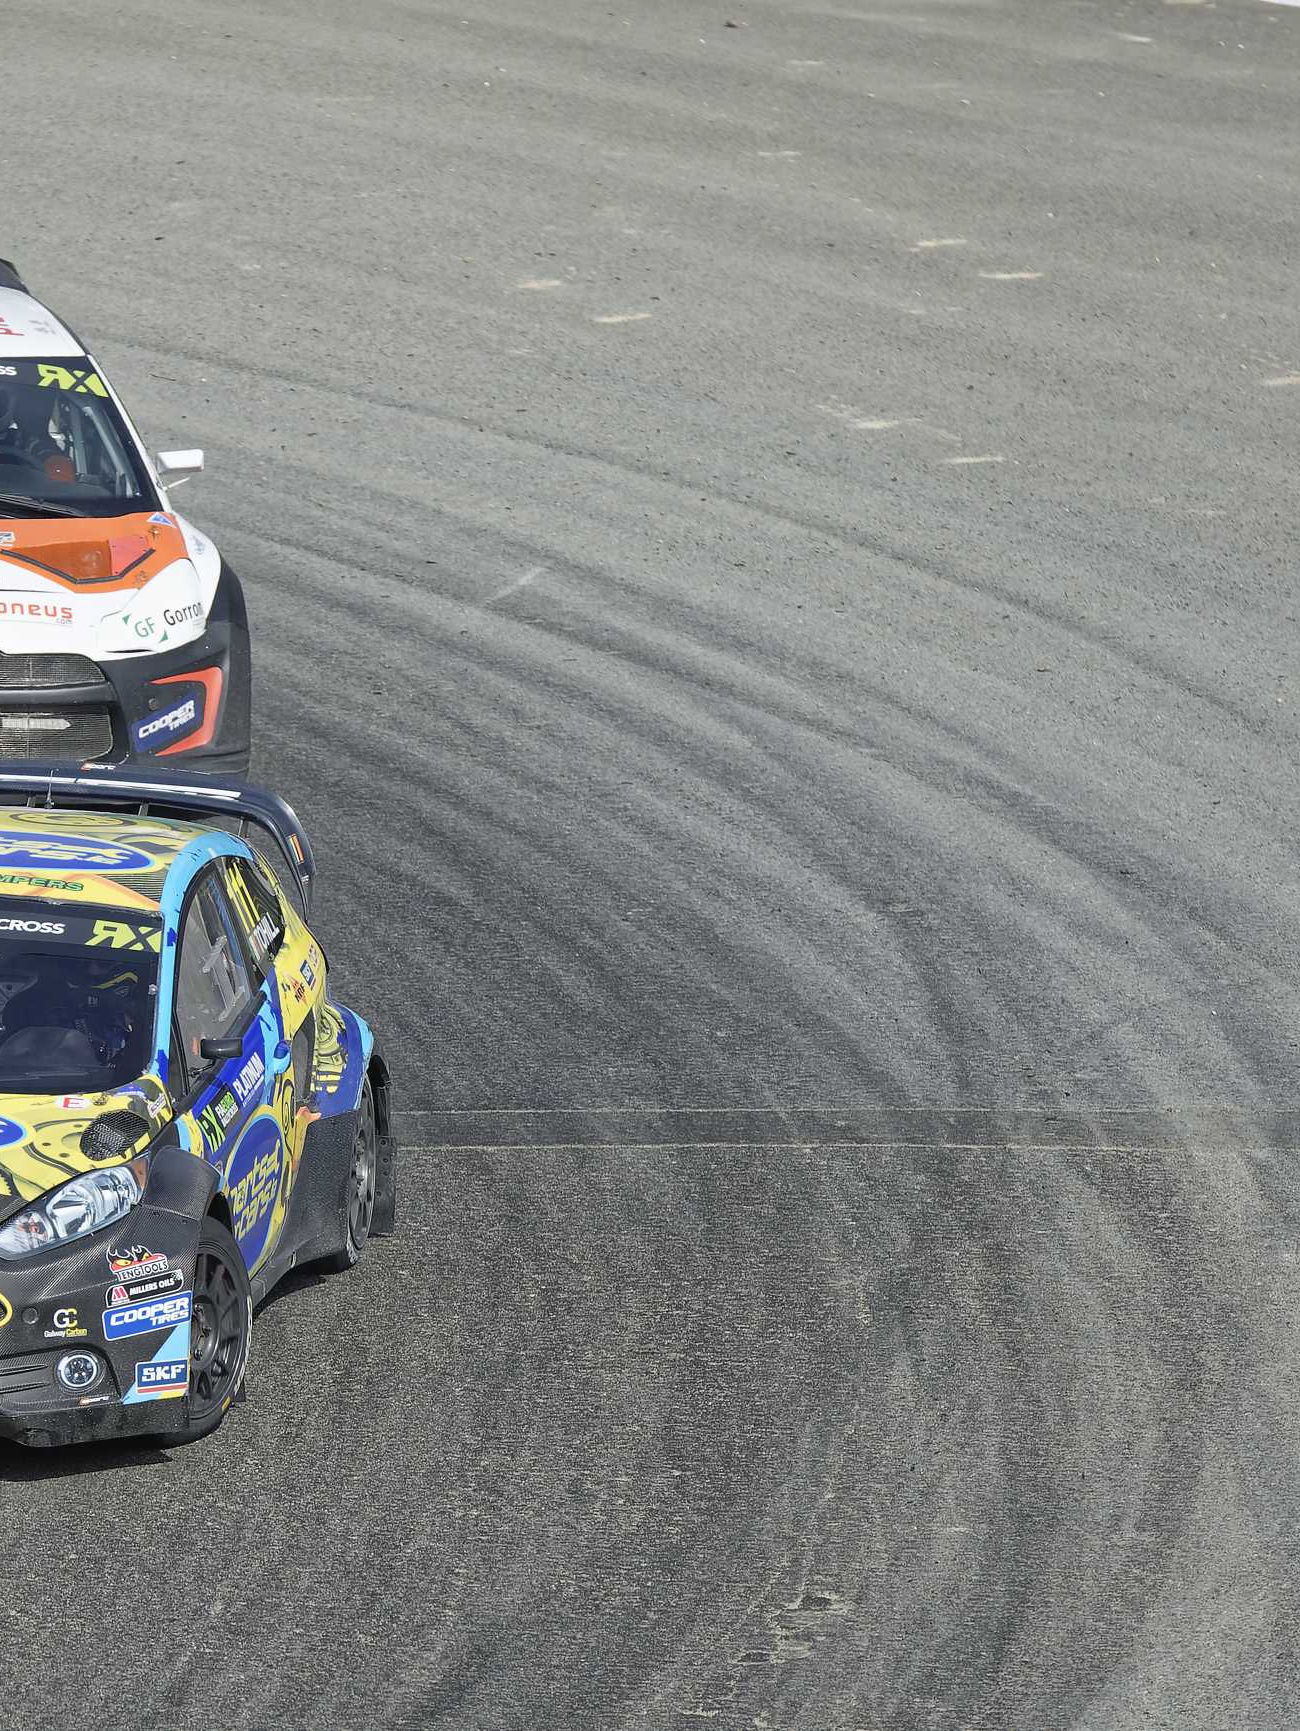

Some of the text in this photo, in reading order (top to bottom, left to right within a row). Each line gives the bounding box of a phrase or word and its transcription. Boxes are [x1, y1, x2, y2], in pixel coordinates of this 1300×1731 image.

[134, 617, 156, 638] GF
[139, 700, 195, 738] COOPER
[232, 1051, 265, 1101] PLATINUM
[129, 1277, 175, 1296] MILLERS OILS
[110, 1297, 190, 1326] COOPER
[150, 1310, 189, 1326] TIRES
[44, 1328, 88, 1338] Galway Carbon
[141, 1364, 185, 1382] SKF
